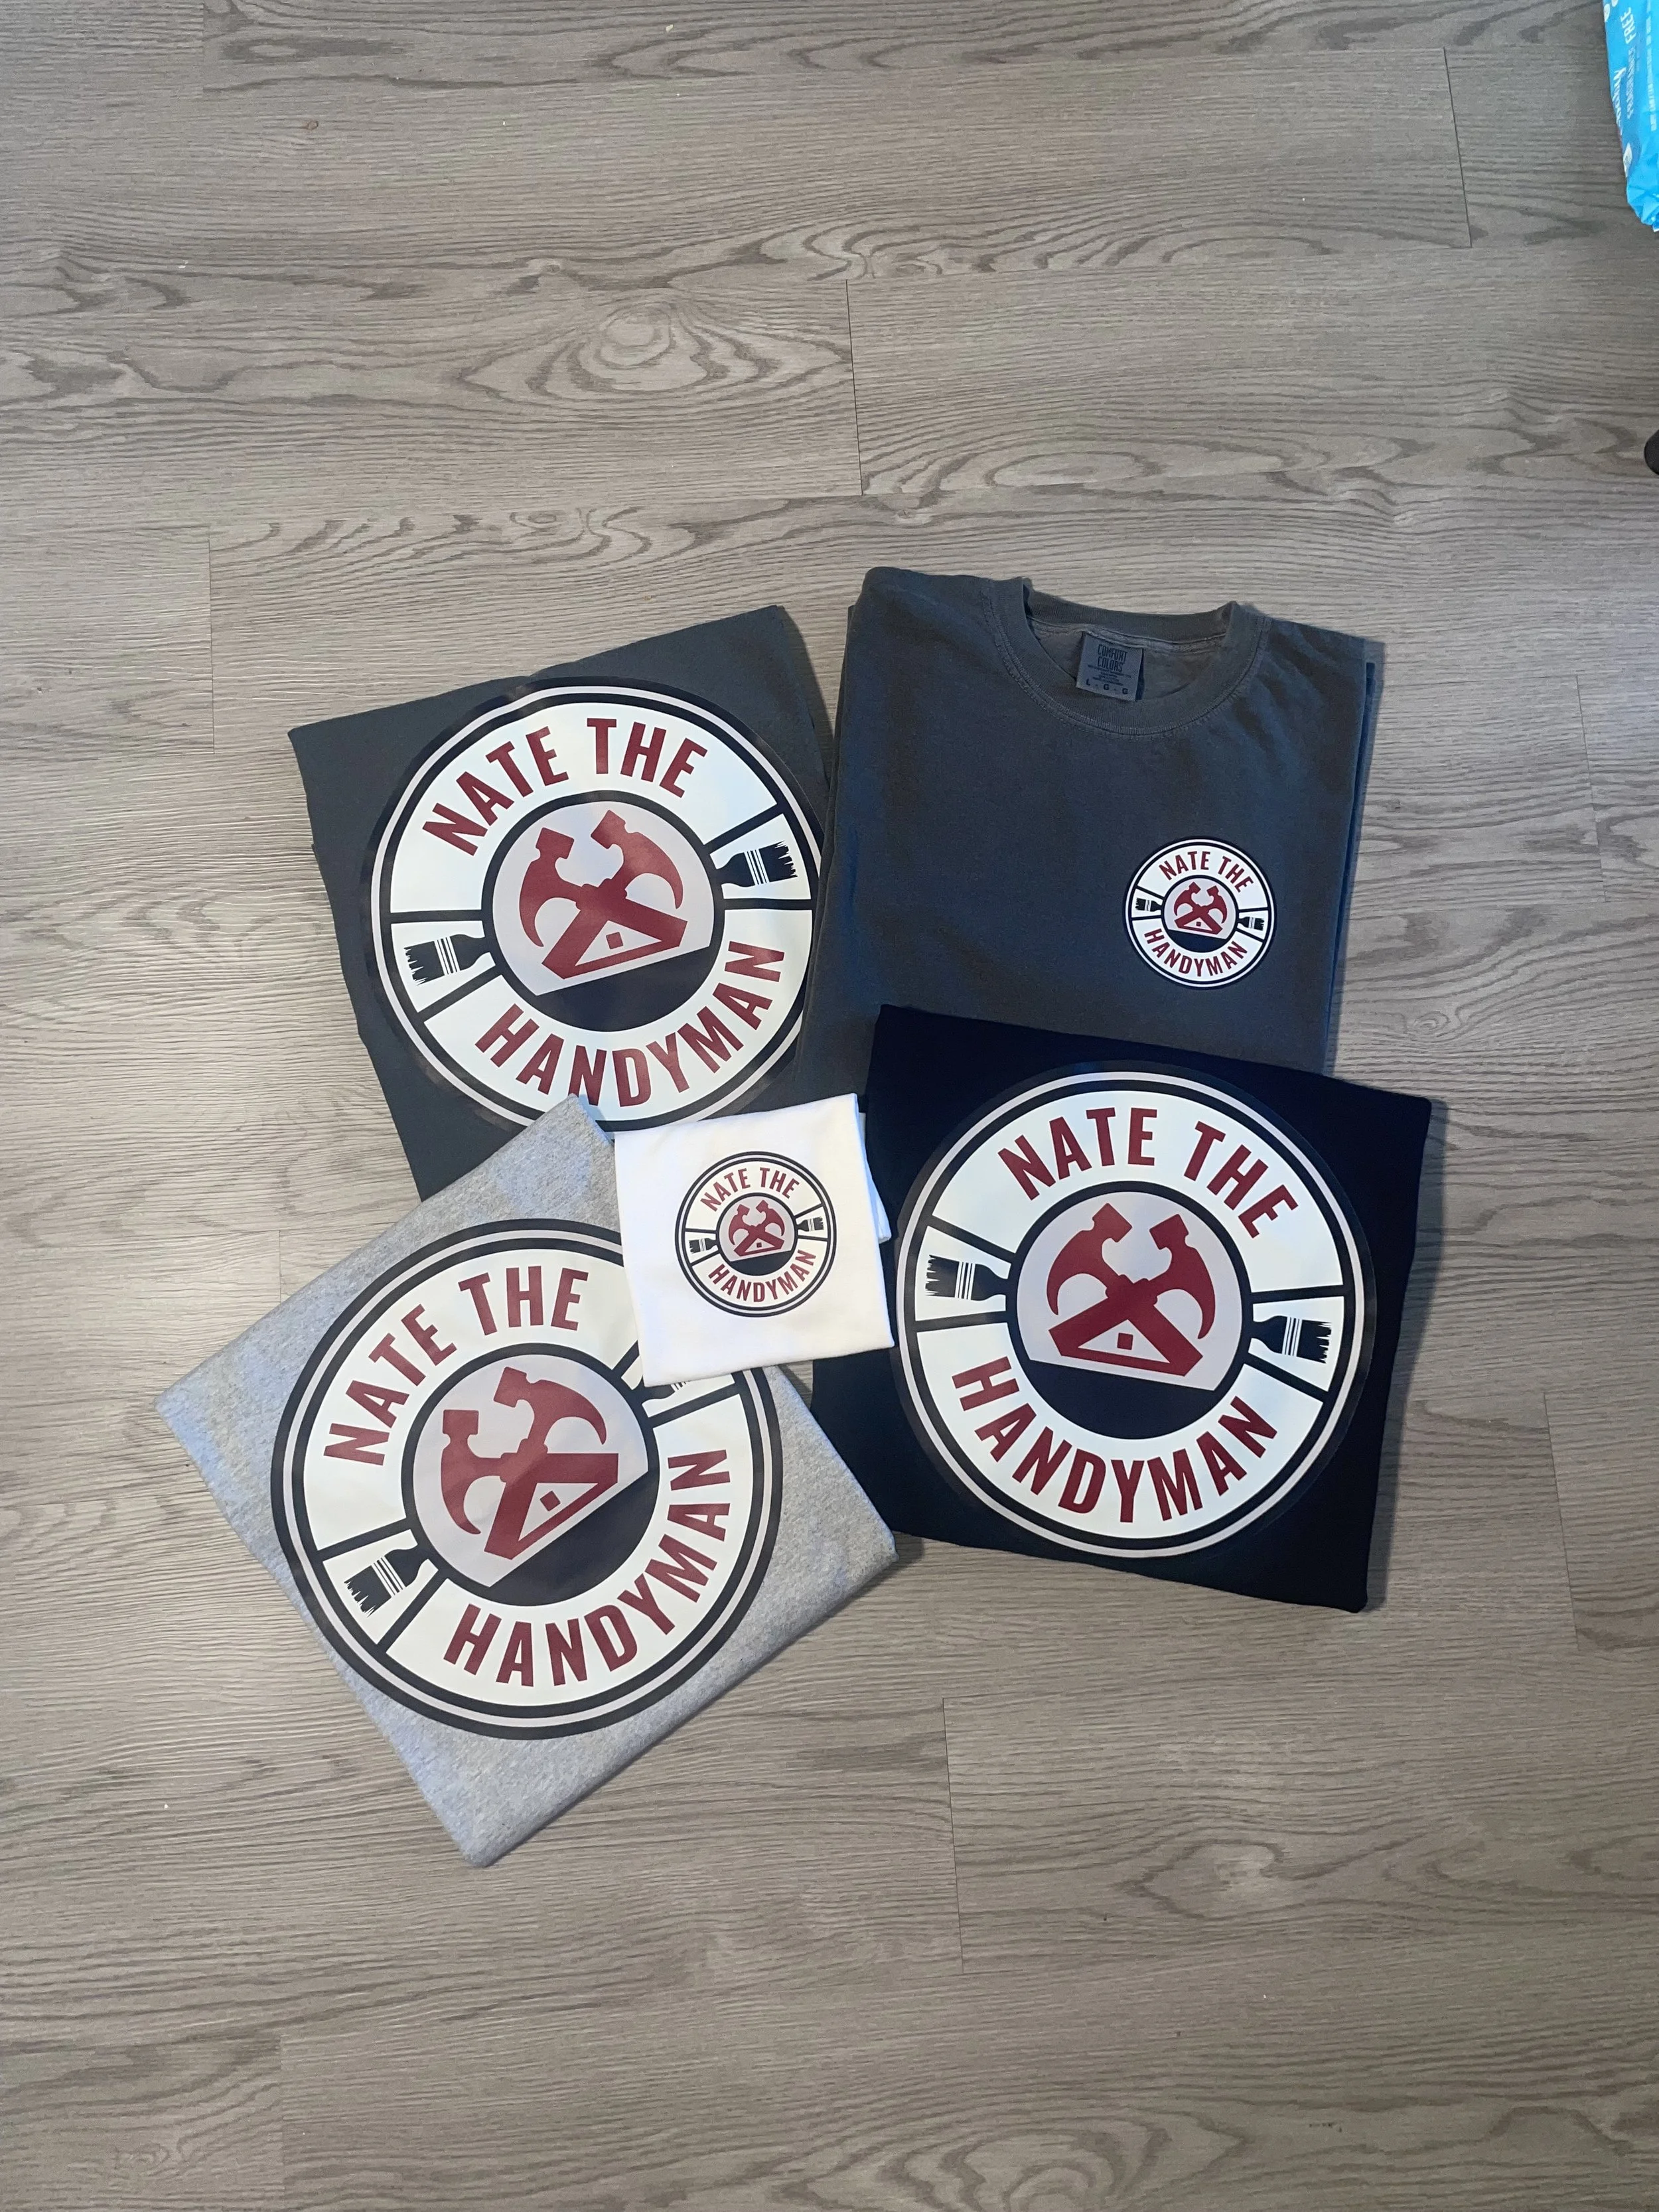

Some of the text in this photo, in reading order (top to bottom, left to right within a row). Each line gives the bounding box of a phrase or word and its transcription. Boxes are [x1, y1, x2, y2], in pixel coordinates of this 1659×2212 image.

[1620, 7, 1636, 44] FREE
[1097, 644, 1128, 662] COMFORT
[1097, 656, 1125, 672] COLORS
[423, 717, 707, 856] NATE THE
[1159, 851, 1254, 893] NATE THE
[1143, 928, 1248, 977] HANDYMAN
[474, 940, 785, 1107] HANDYMAN
[699, 1167, 800, 1212] NATE THE
[997, 1106, 1299, 1239] NATE THE
[707, 1249, 817, 1303] HANDYMAN
[323, 1265, 589, 1466] NATE THE
[951, 1356, 1278, 1523] HANDYMAN
[443, 1449, 731, 1688] HANDYMAN
